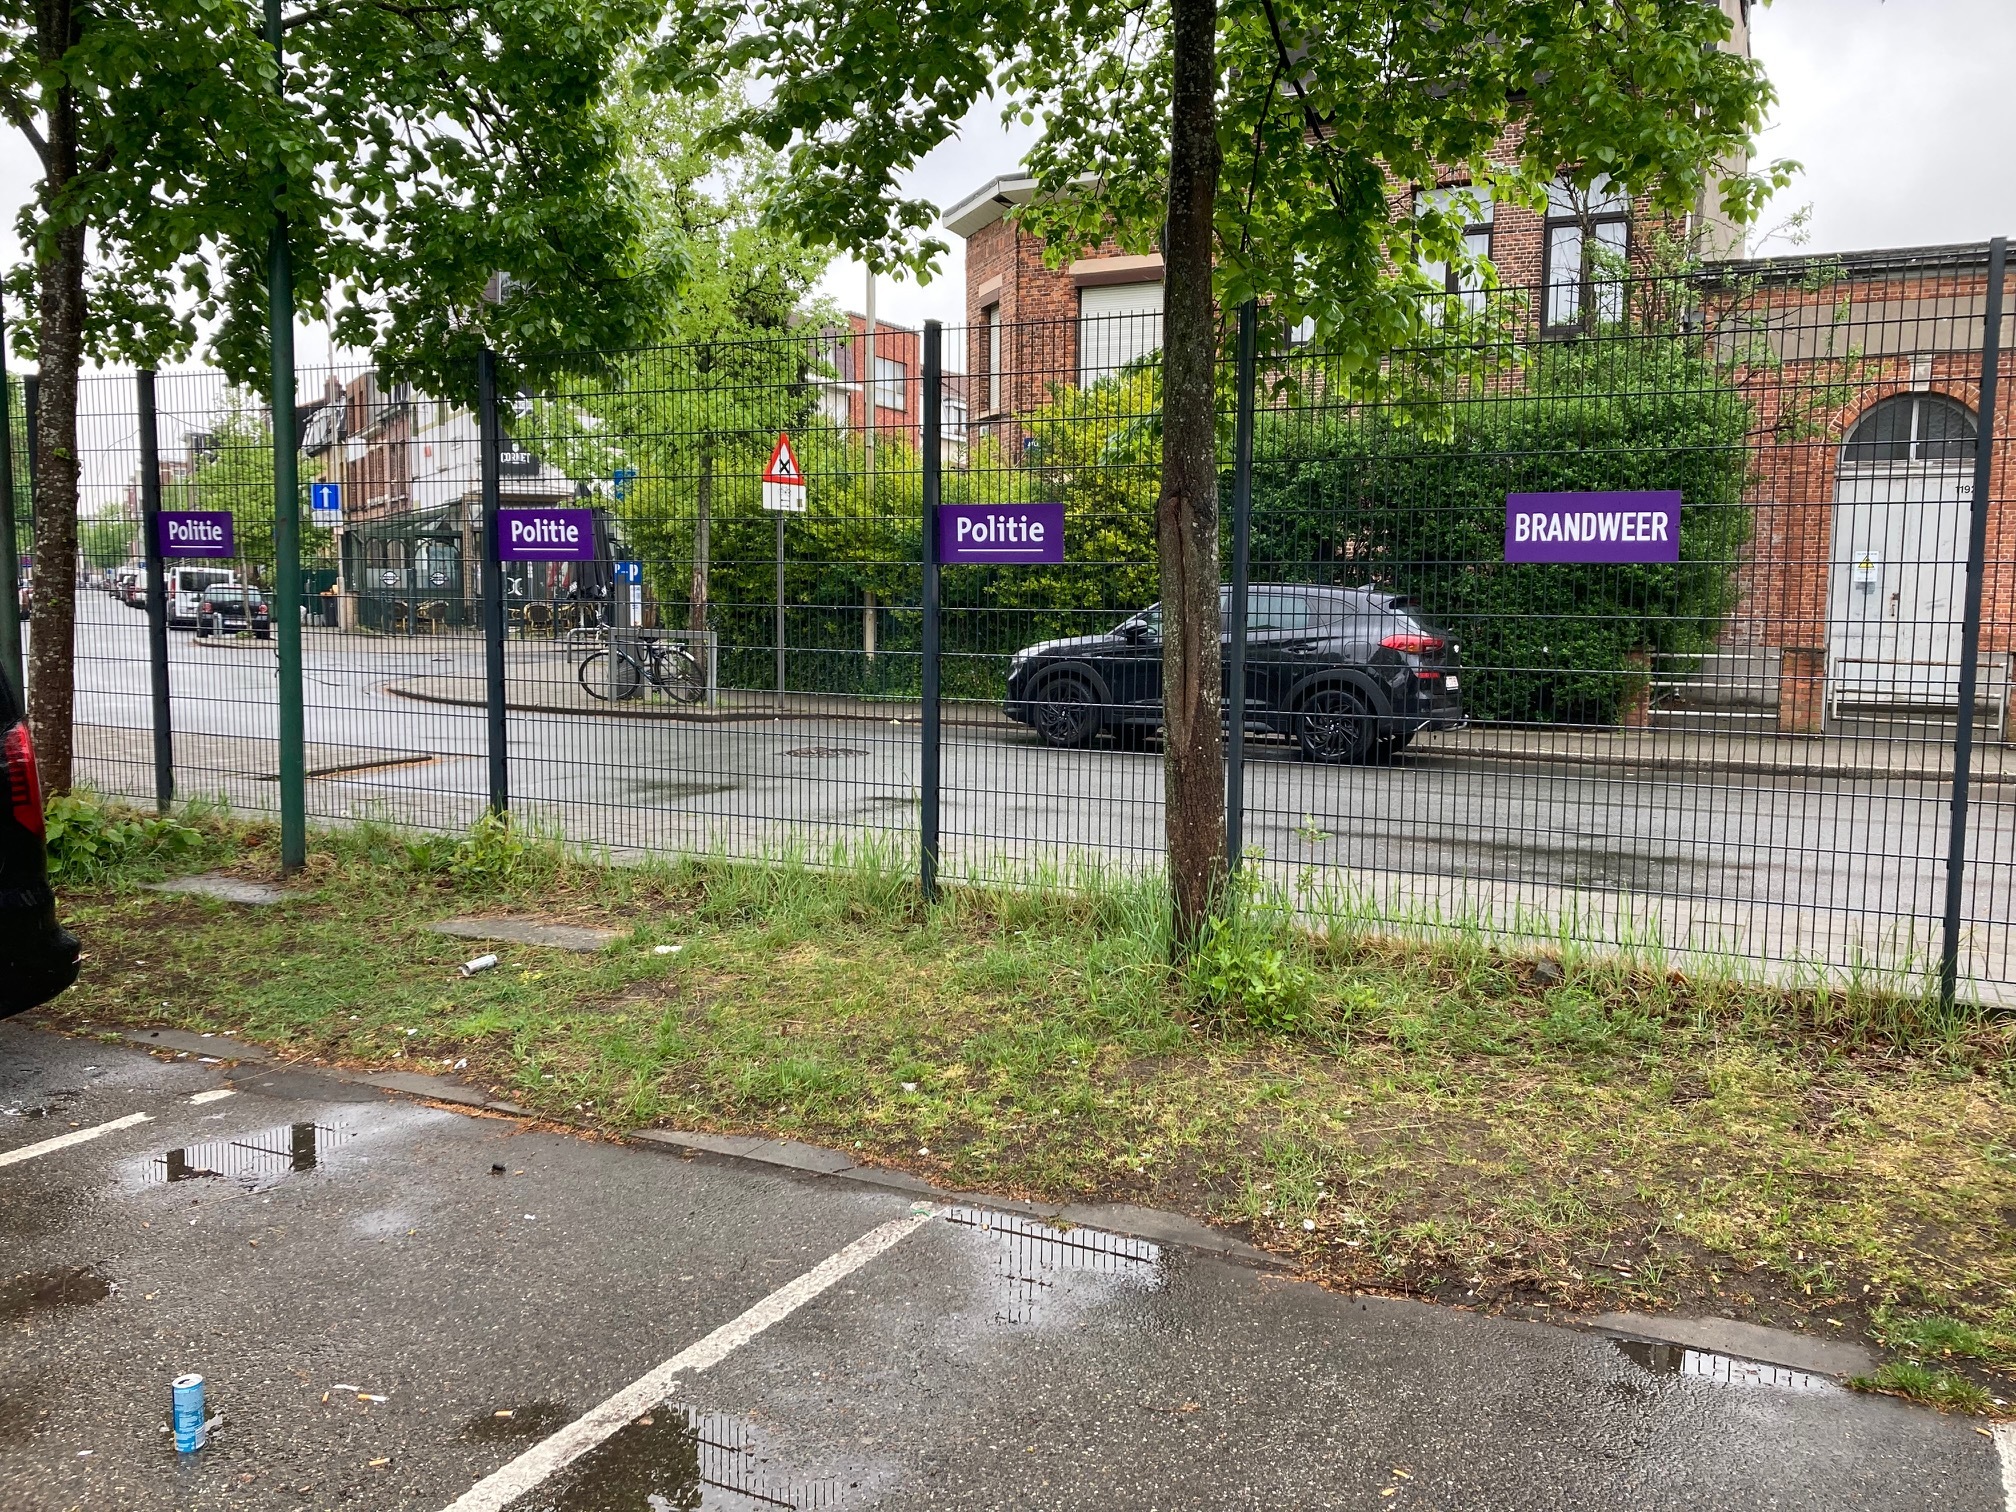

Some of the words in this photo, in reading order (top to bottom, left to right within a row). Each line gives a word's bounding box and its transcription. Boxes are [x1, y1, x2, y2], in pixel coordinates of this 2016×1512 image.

[168, 519, 222, 541] Politie
[511, 518, 579, 542] Politie
[957, 514, 1045, 542] Politie
[1515, 511, 1668, 542] BRANDWEER
[629, 563, 639, 582] P
